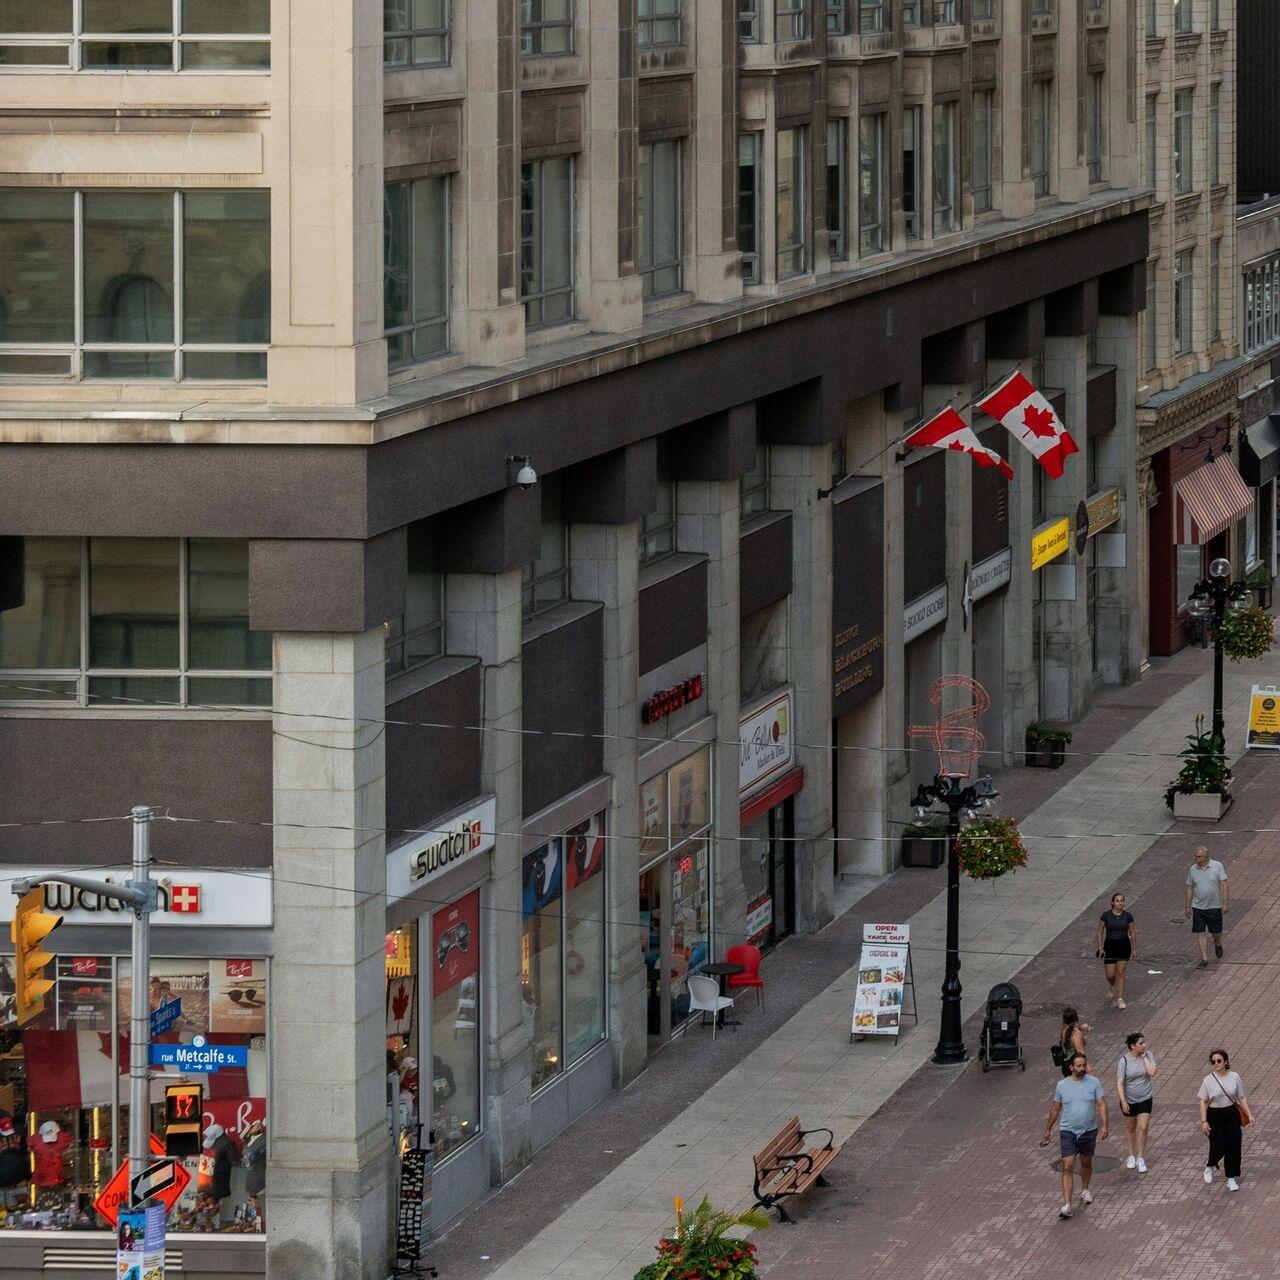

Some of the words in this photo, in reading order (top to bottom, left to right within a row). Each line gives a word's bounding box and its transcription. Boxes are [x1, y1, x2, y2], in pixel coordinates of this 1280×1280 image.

[411, 821, 471, 880] swatch
[161, 1053, 174, 1062] rue
[176, 1049, 225, 1063] Metcalfe
[227, 1053, 237, 1063] St.
